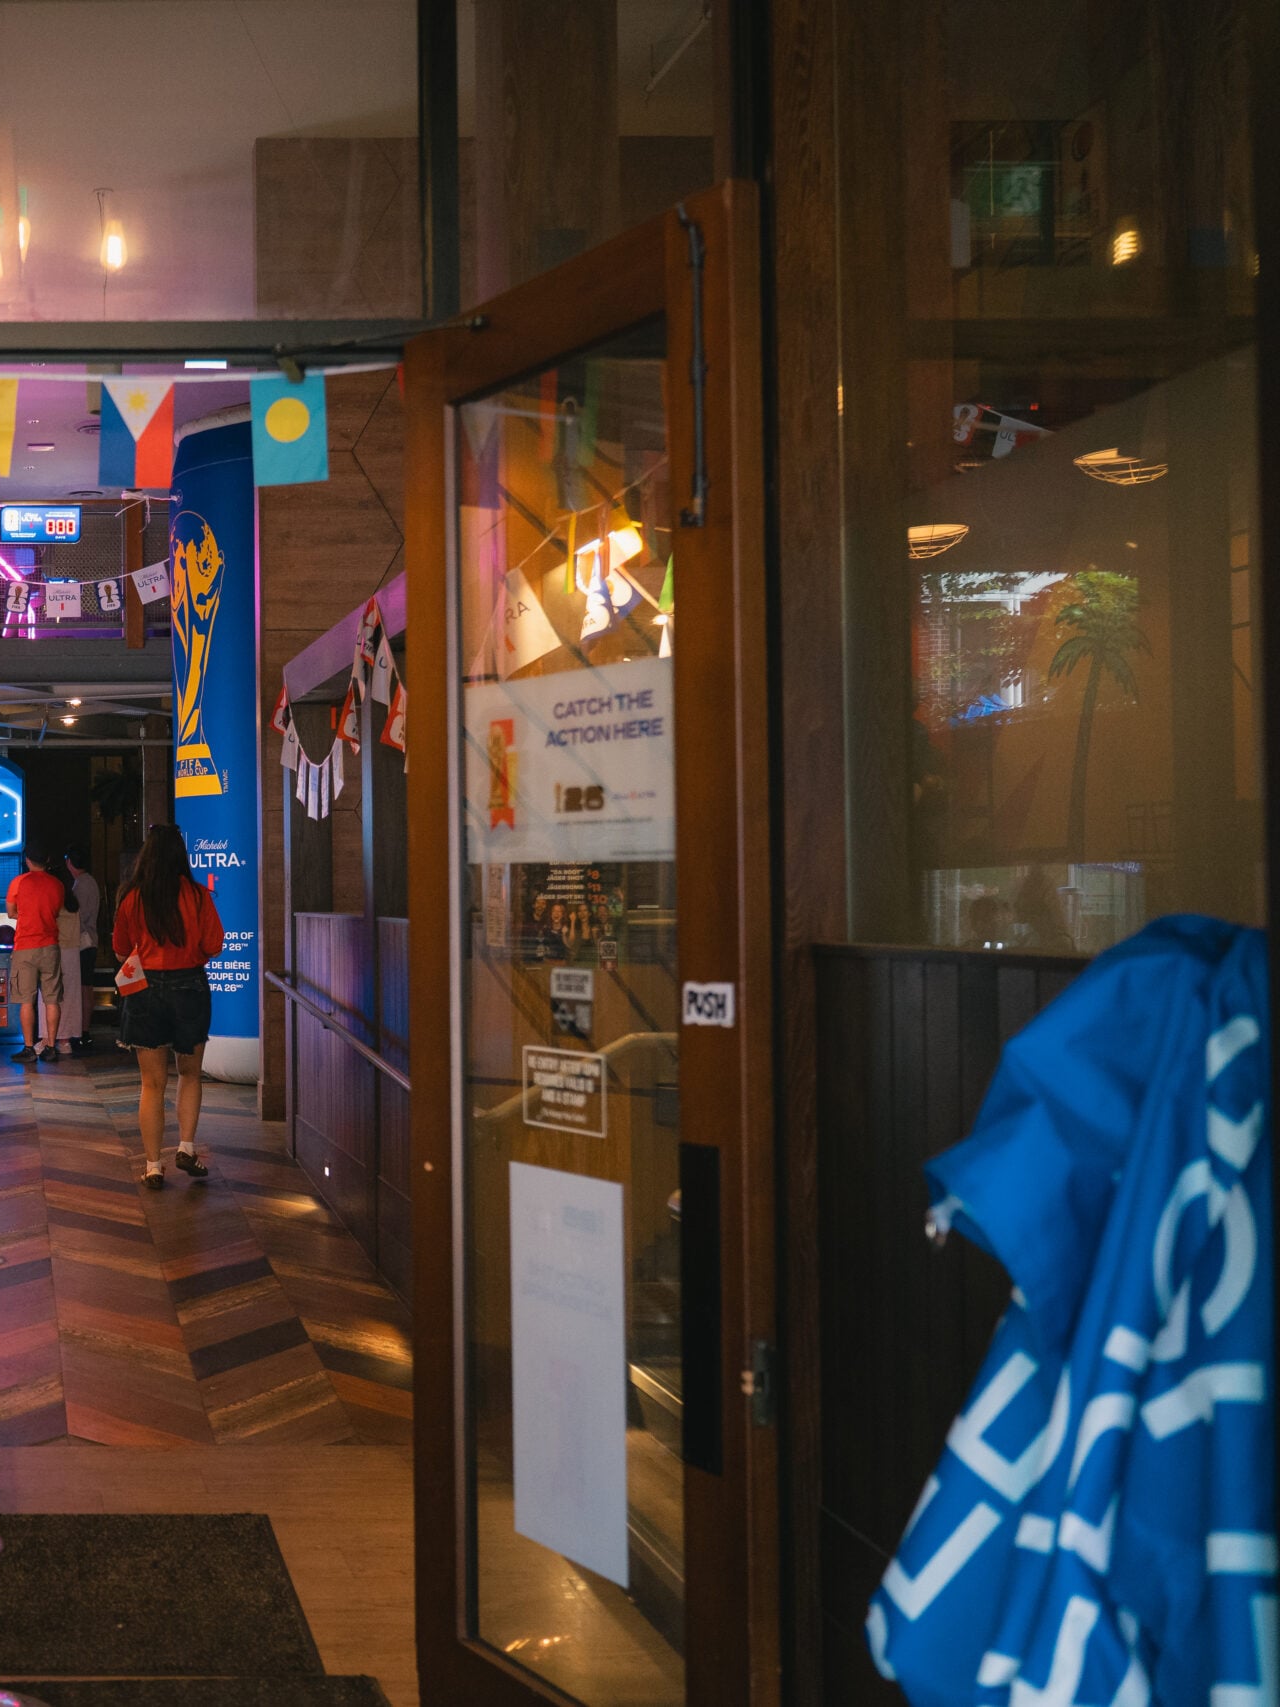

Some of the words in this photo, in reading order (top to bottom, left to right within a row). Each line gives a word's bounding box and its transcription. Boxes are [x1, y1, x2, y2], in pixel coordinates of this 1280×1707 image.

[138, 574, 165, 588] ULTRA
[553, 697, 612, 720] CATCH
[615, 690, 654, 711] THE
[546, 725, 610, 747] ACTION
[613, 717, 664, 740] HERE
[181, 759, 202, 769] FIFA
[195, 767, 208, 775] CUP
[194, 839, 228, 852] Michelob
[224, 960, 251, 969] BIÈRE
[688, 991, 726, 1019] PUSH
